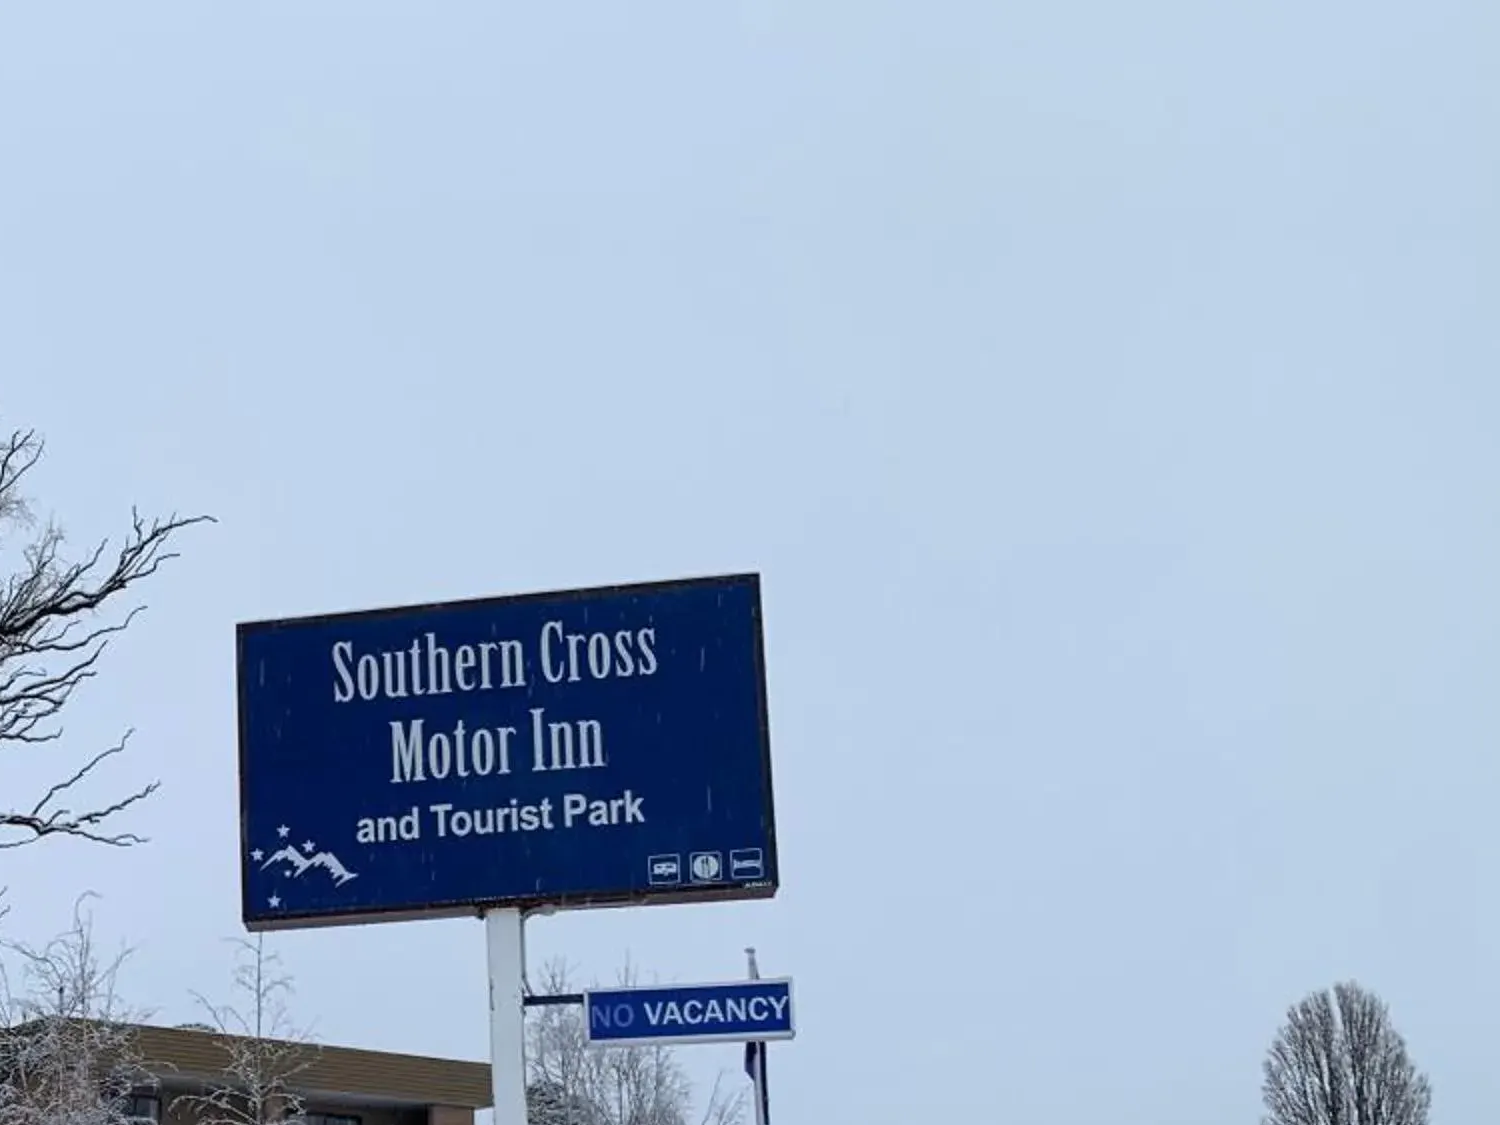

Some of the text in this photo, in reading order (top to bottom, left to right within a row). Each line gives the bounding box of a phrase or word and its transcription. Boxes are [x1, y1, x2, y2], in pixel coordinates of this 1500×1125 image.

[333, 620, 657, 702] Southern Cross
[388, 707, 607, 783] Motor Inn
[356, 789, 645, 843] and Tourist Park
[591, 995, 788, 1028] NO VACANCY
